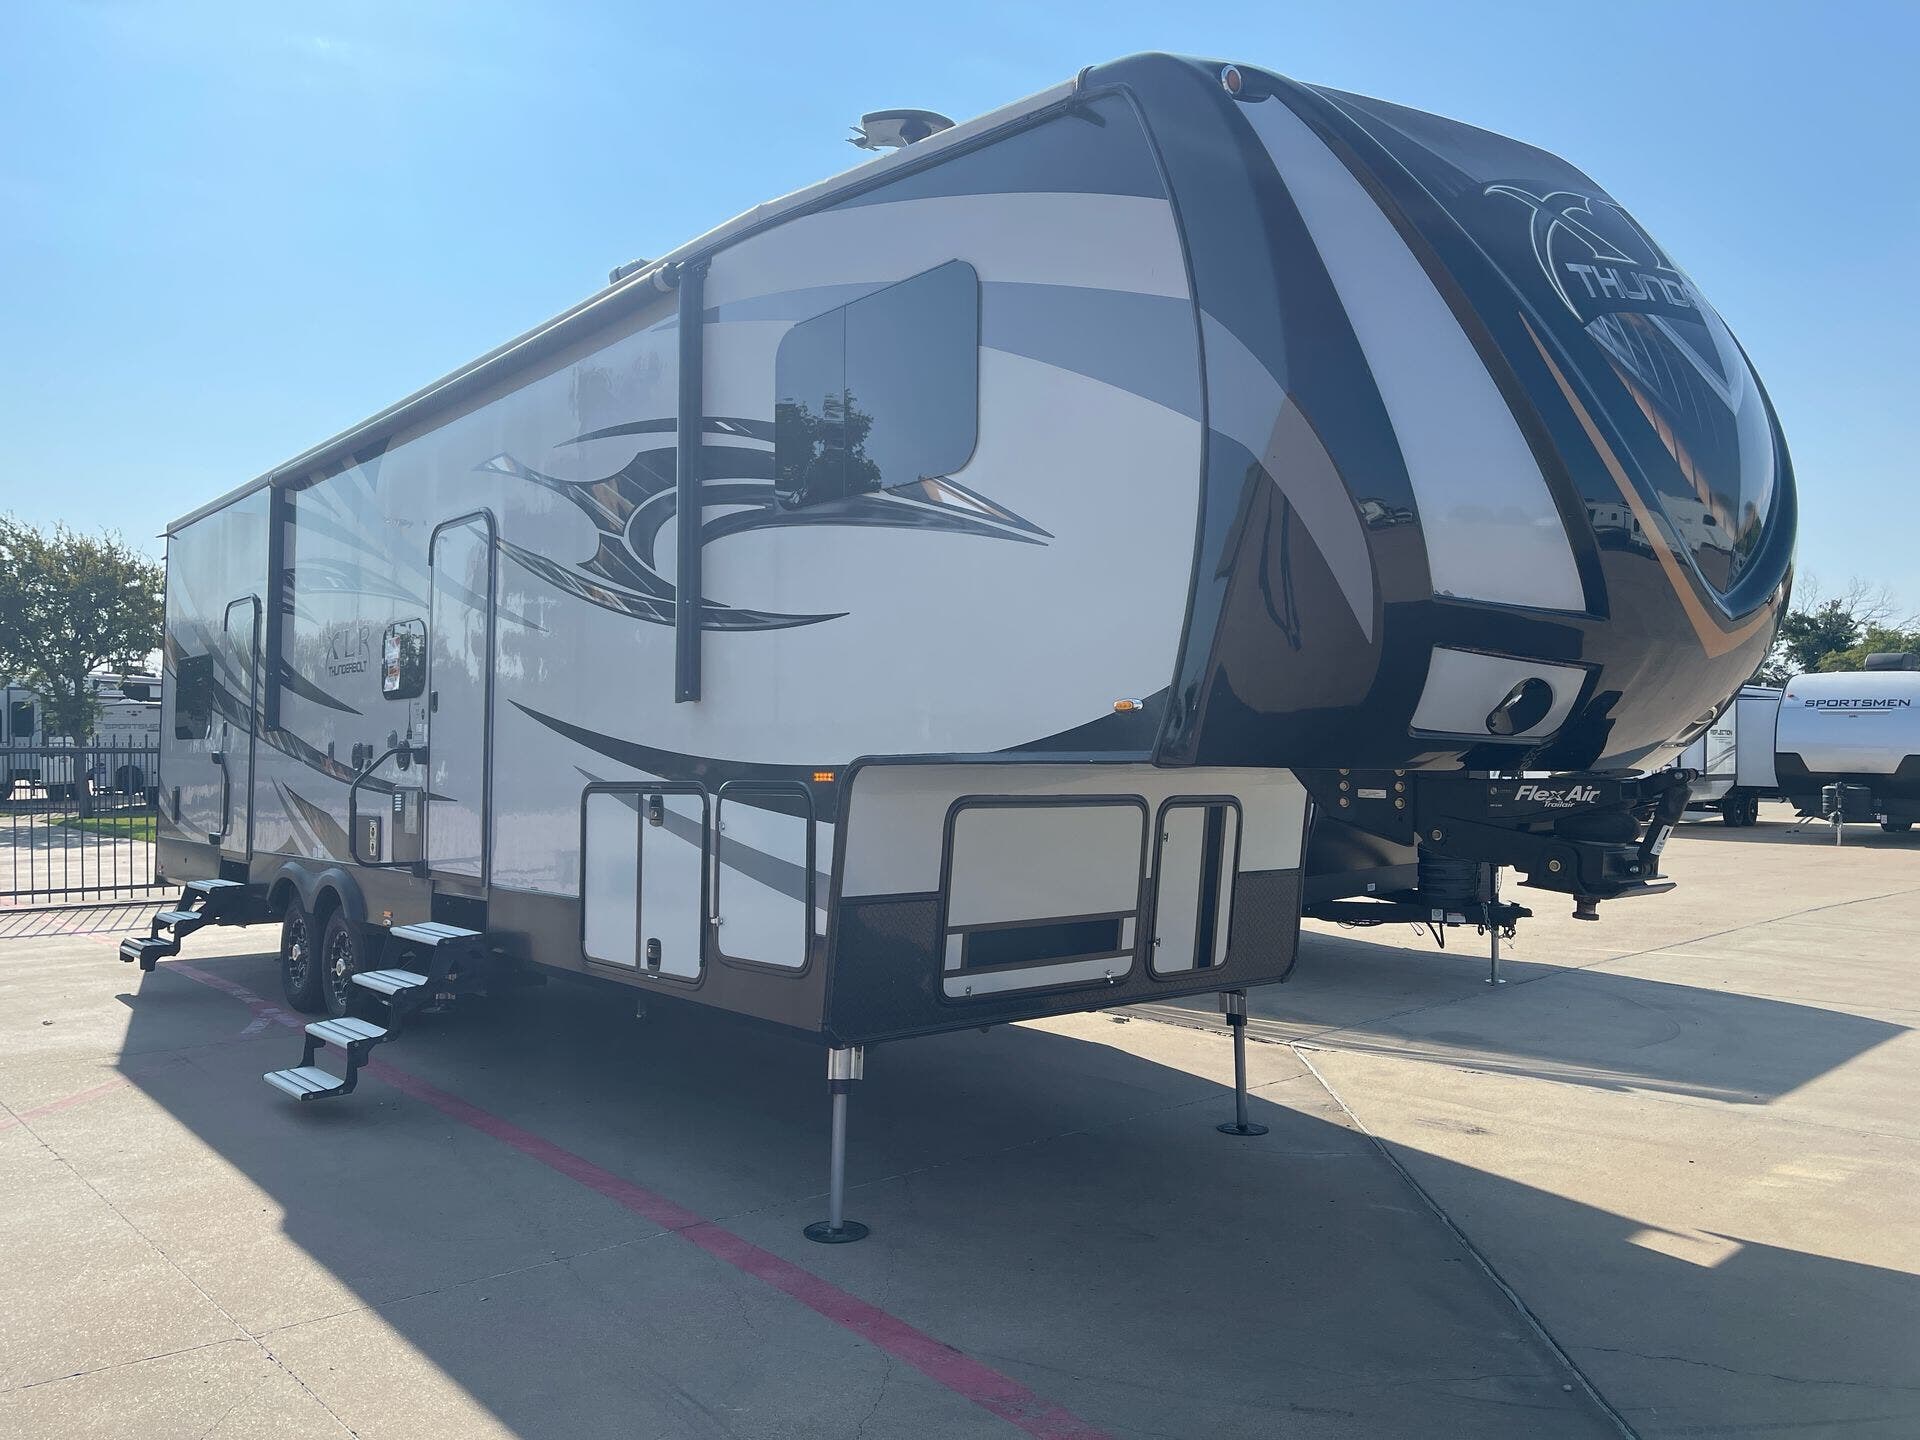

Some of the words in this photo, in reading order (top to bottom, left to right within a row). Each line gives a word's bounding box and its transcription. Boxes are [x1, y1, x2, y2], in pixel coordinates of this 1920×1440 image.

[1565, 263, 1693, 308] THUND
[328, 661, 368, 677] THUNDERBOLT
[1804, 699, 1912, 708] SPORTSMEN
